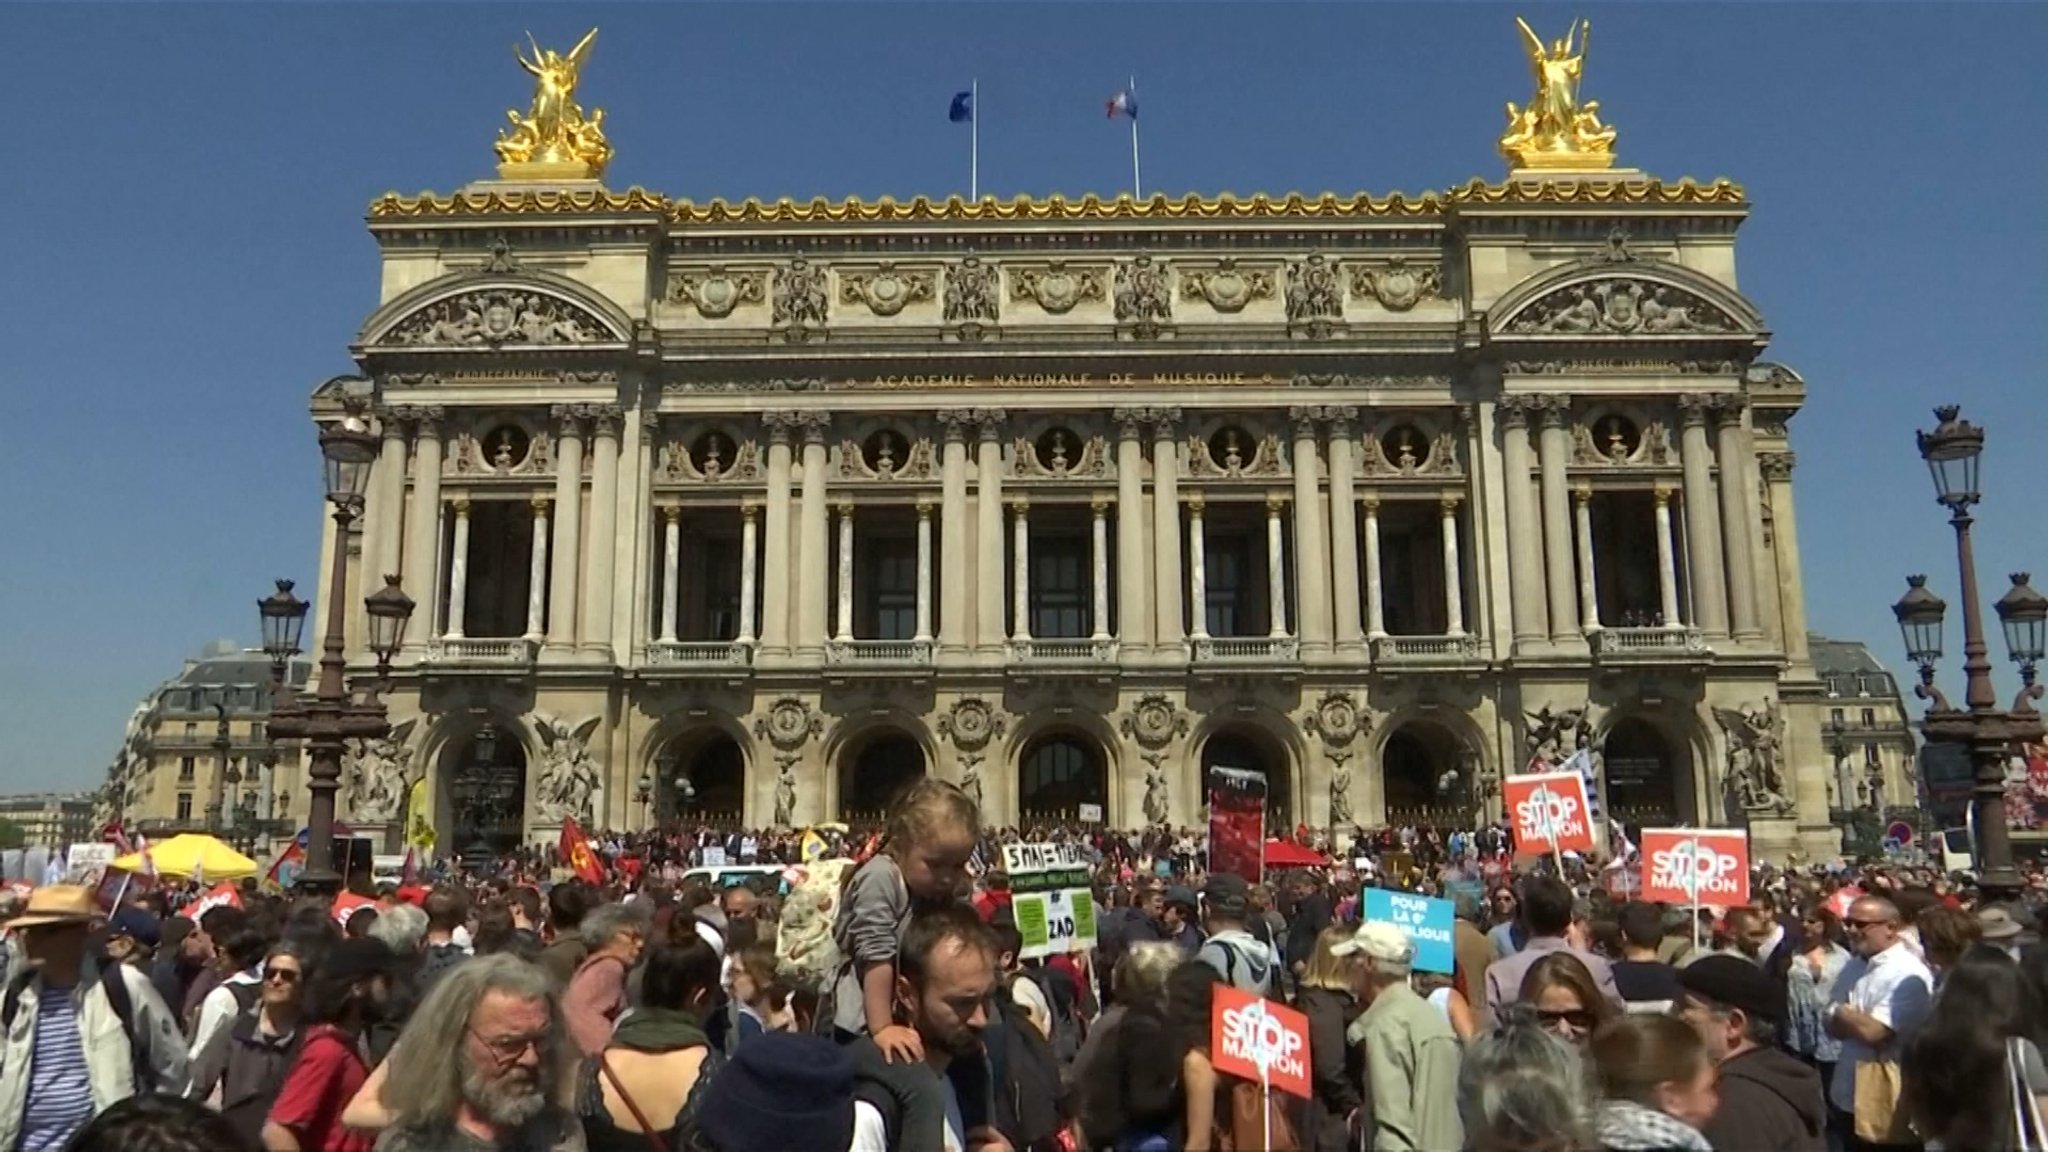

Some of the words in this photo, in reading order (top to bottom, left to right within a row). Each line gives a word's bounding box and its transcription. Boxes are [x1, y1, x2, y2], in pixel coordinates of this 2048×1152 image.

[873, 374, 975, 387] ACADEMIE
[993, 373, 1091, 386] NATIONALE
[1109, 373, 1135, 385] DE
[1152, 373, 1245, 386] MUSIQUE
[1516, 796, 1578, 827] STOP
[1519, 819, 1584, 844] MARON
[1651, 850, 1739, 878] STOP
[1651, 873, 1739, 894] MARON
[1390, 895, 1428, 912] POUR
[1393, 908, 1410, 922] LA
[1048, 917, 1074, 939] ZAD
[1222, 1007, 1302, 1056] STOP
[1222, 1036, 1305, 1080] MARON
